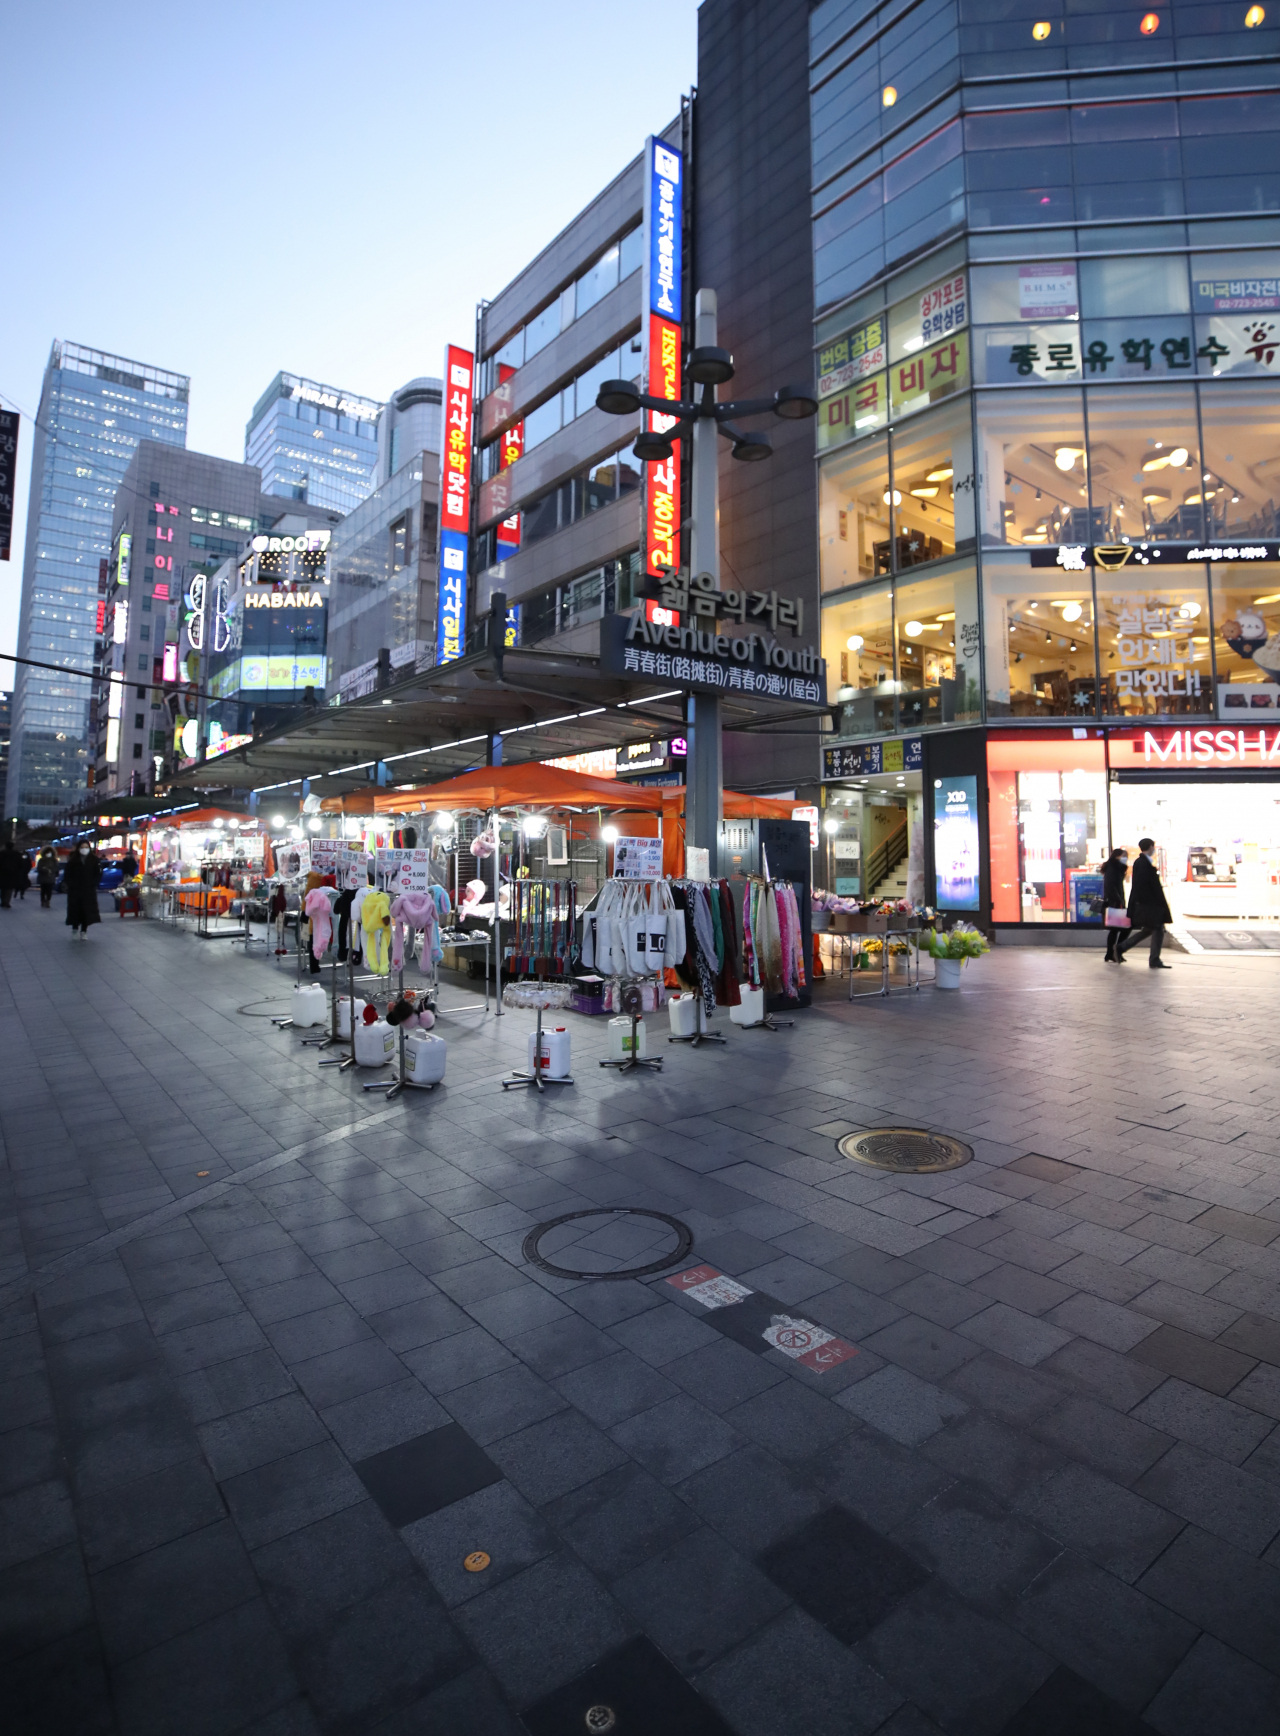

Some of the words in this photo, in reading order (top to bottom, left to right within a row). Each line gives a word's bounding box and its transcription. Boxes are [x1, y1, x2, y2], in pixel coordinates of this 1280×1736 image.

[657, 178, 675, 314] 공부기술연구소
[921, 276, 965, 318] 싱가포르
[1199, 279, 1280, 298] 미국비자전
[922, 301, 966, 342] 유학상담
[820, 338, 849, 376] 번역
[851, 320, 883, 358] 공증
[1009, 336, 1231, 376] 종로유학연수
[828, 380, 879, 427] 미국
[899, 342, 960, 393] 비자
[447, 389, 469, 517] 시사유학닷컴
[245, 592, 323, 609] HABANA
[656, 563, 747, 625] 젊음의
[750, 590, 804, 637] 거리
[440, 576, 463, 665] 시사일본
[1116, 607, 1194, 634] 설빙은
[624, 609, 730, 659] Avenue
[731, 633, 758, 662] of
[757, 637, 824, 676] Youth
[1117, 638, 1196, 666] 언제나
[1115, 668, 1202, 698] 맛있다!
[843, 754, 862, 769] 설빙
[871, 745, 880, 772] 보청기
[910, 741, 922, 754] 연
[833, 750, 841, 776] 부동산
[313, 841, 349, 851] 밍크목도리
[414, 850, 426, 859] Big
